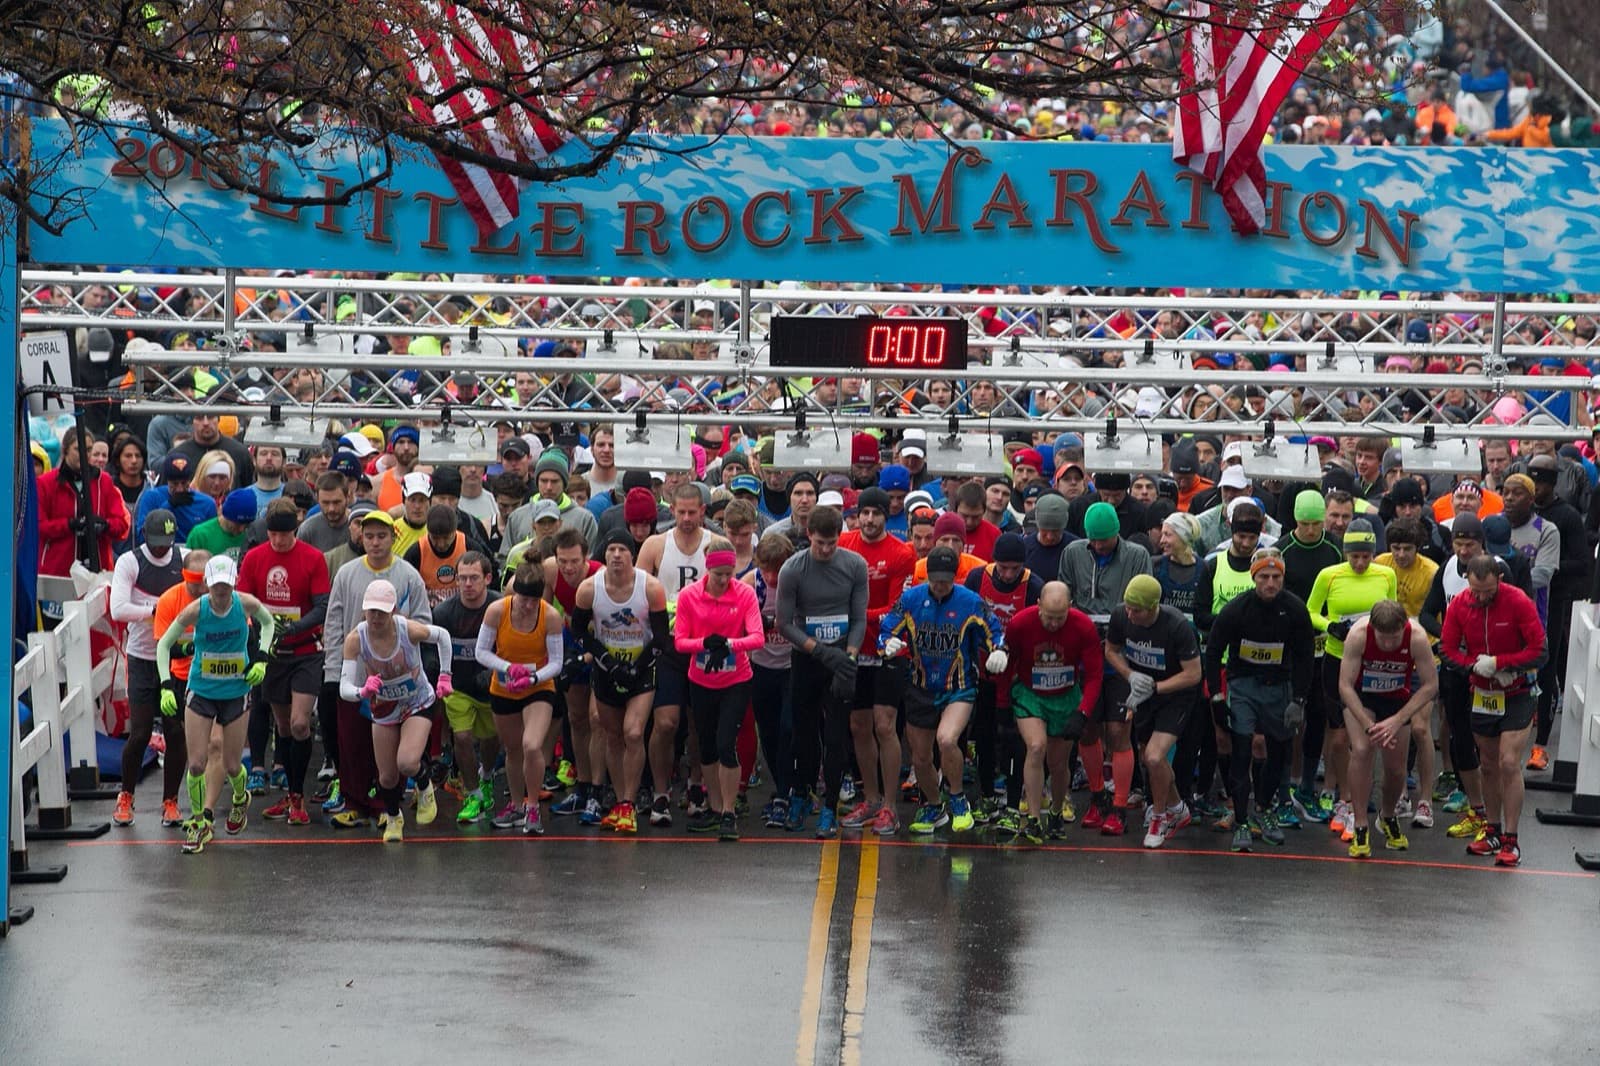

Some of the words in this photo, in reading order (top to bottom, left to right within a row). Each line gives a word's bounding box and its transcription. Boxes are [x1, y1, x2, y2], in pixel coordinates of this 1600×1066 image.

[615, 186, 866, 256] ROCK
[27, 341, 60, 356] CORRAL
[869, 326, 945, 363] 0:00
[43, 360, 64, 411] A
[815, 626, 841, 639] 6195
